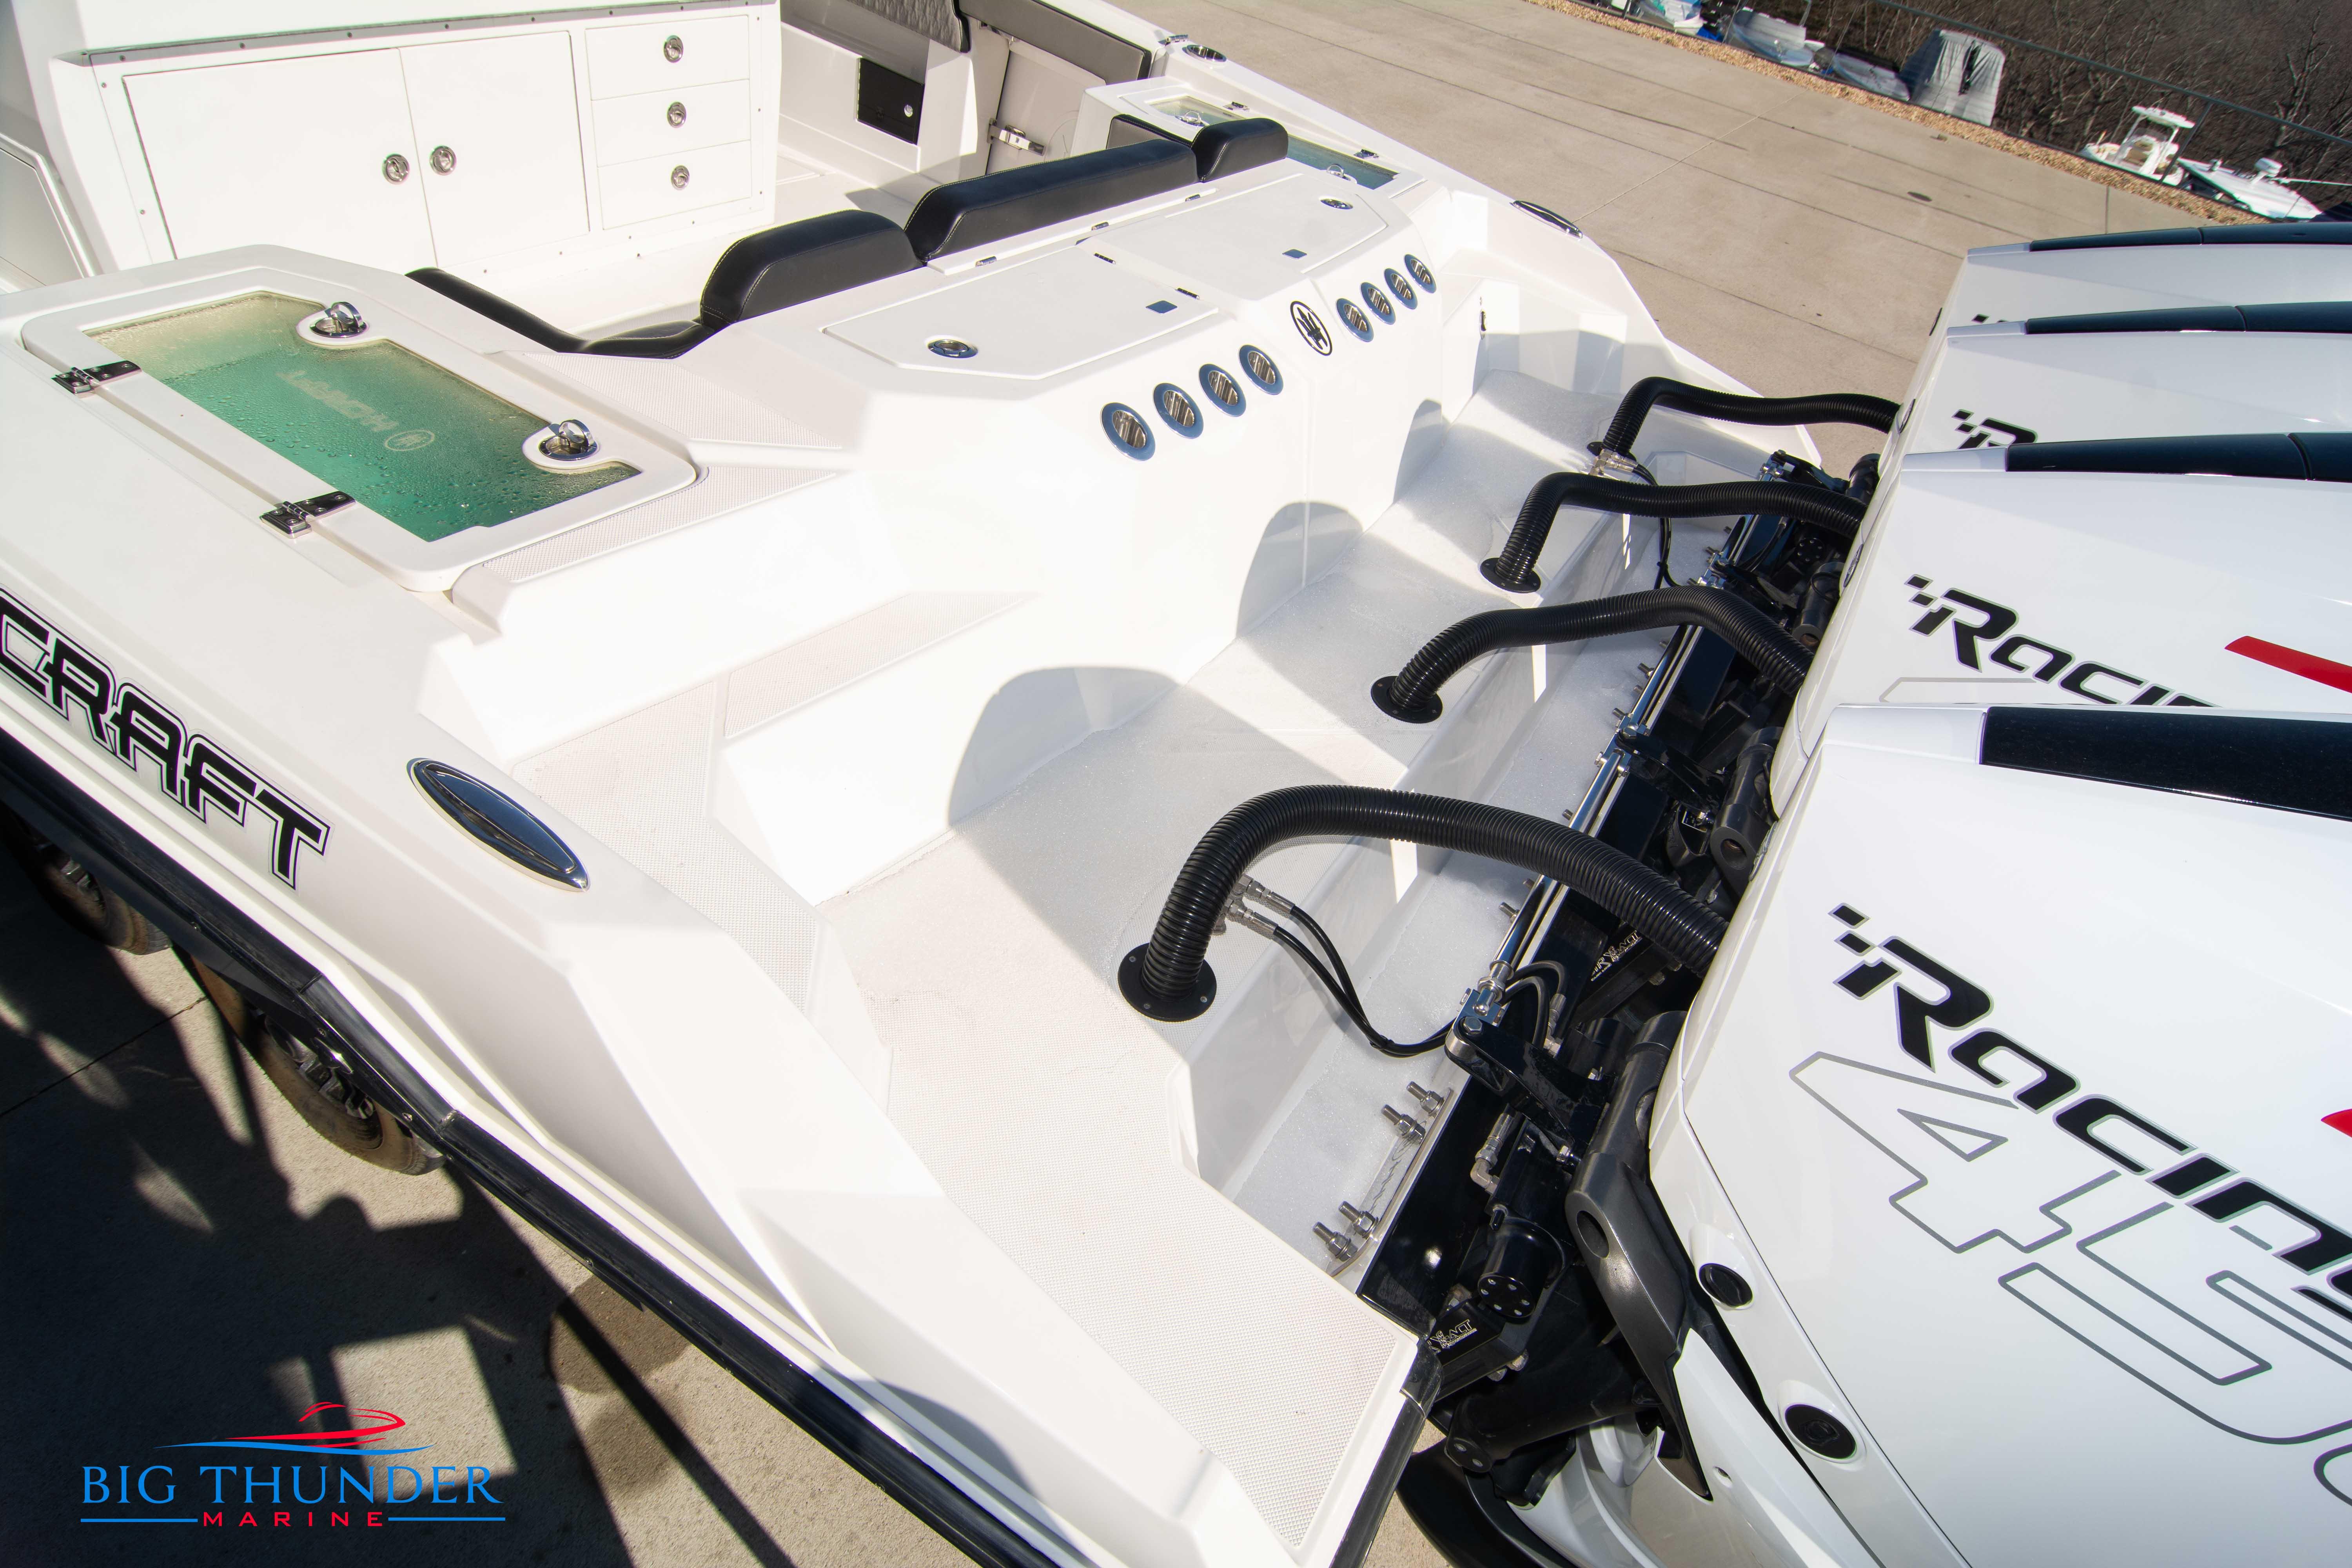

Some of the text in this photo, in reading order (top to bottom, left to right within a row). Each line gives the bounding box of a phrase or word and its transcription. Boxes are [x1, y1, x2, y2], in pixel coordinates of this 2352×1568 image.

[0, 587, 331, 890] CRAFT
[1904, 574, 2223, 707] Raci
[1788, 1051, 2352, 1506] 45
[1828, 902, 2352, 1323] Racin
